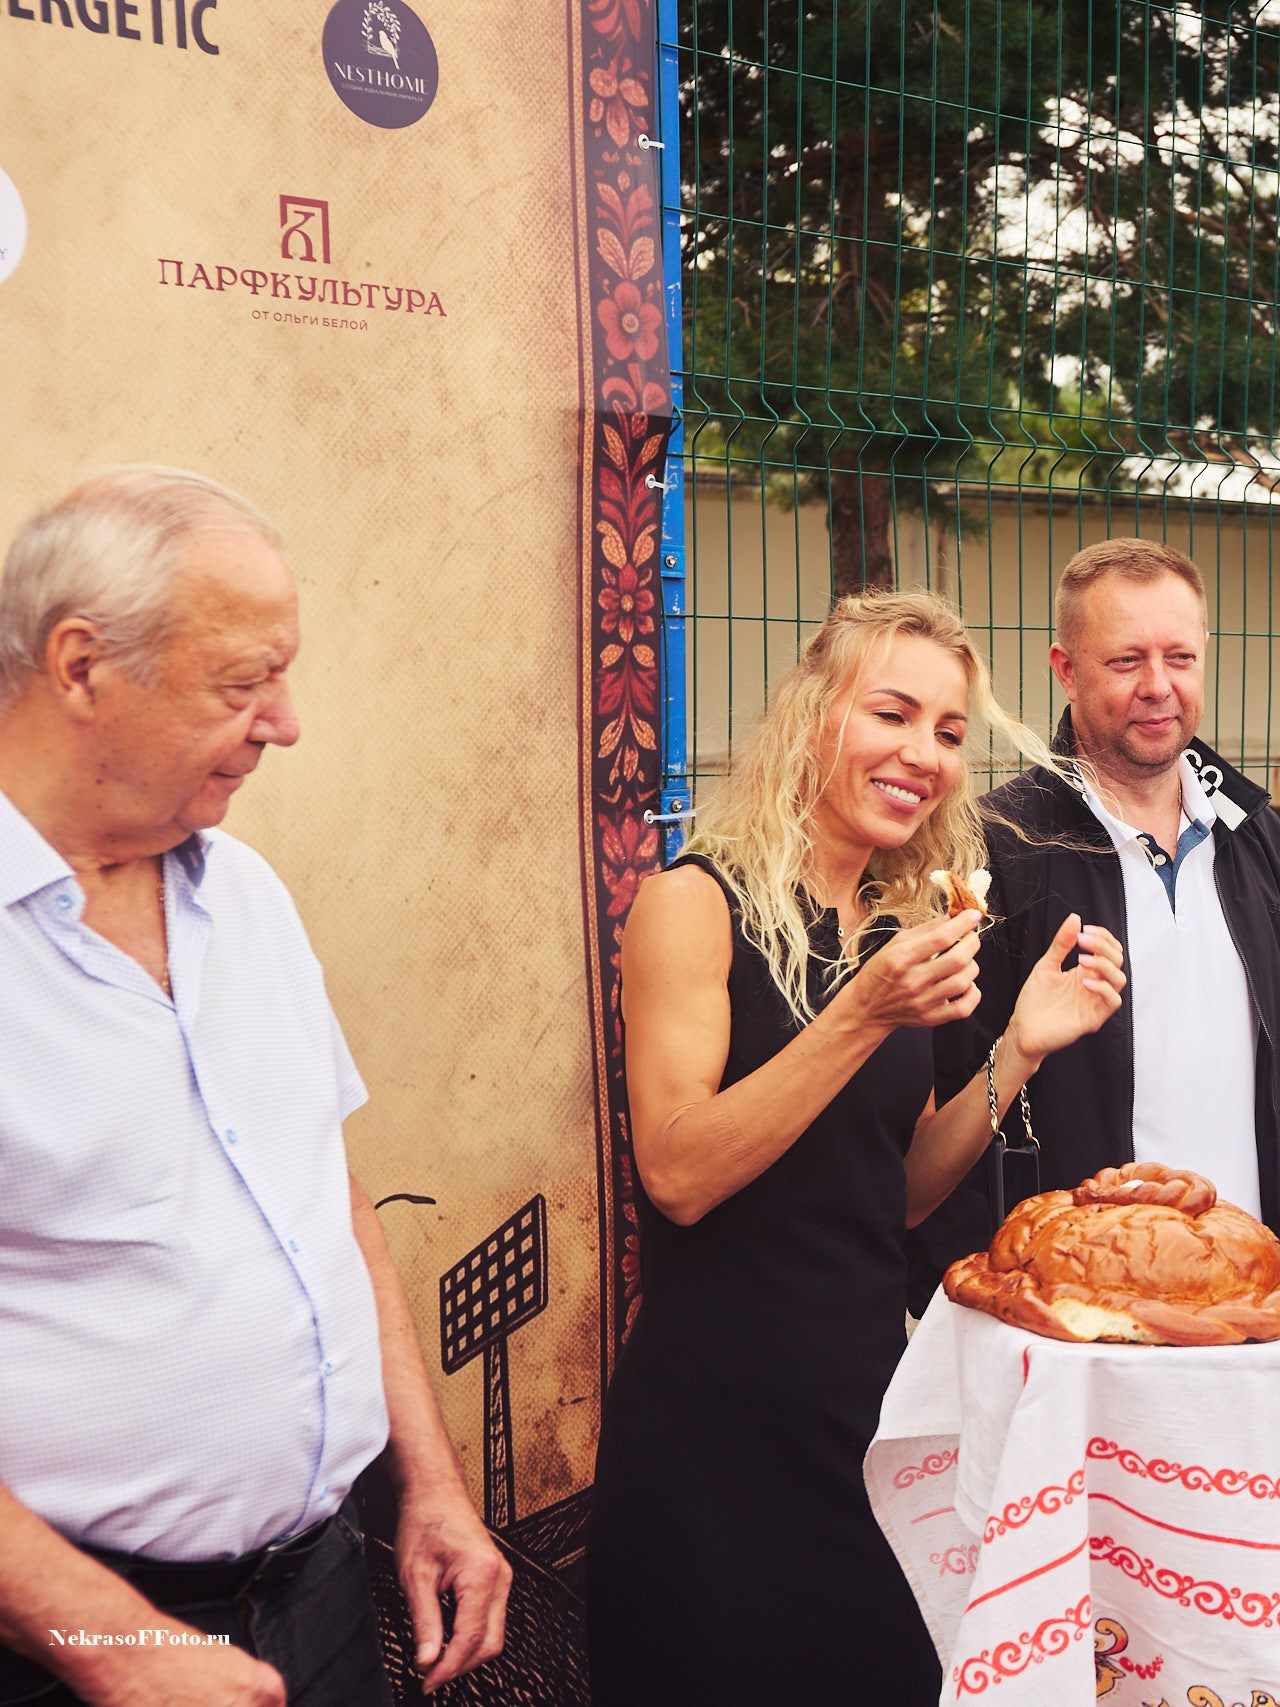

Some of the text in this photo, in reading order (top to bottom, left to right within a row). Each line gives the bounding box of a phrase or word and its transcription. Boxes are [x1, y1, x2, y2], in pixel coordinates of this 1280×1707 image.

[334, 62, 429, 95] NESTHOME
[157, 257, 448, 317] ПАРФКУЛЬТУРА
[251, 310, 368, 331] ОТ ОЛЬГИ БЕЛОЙ
